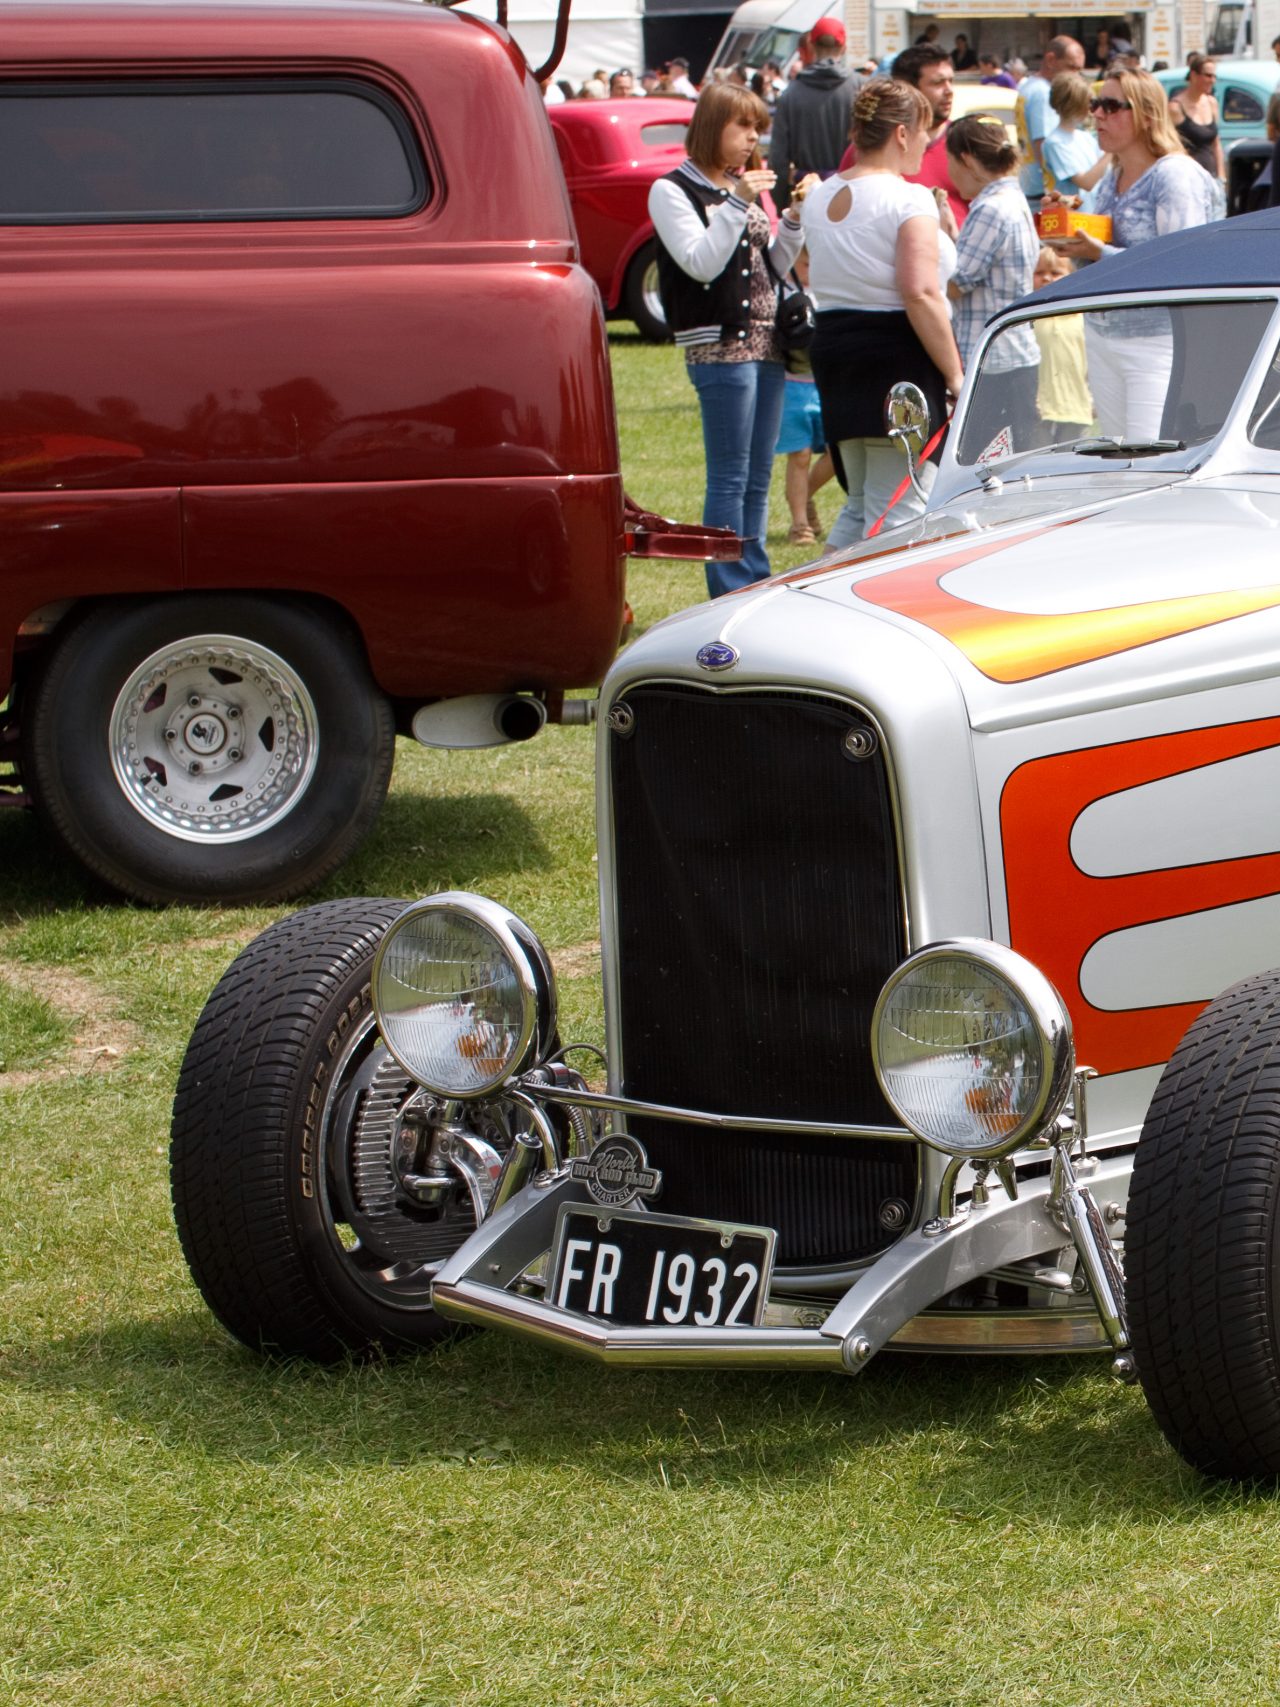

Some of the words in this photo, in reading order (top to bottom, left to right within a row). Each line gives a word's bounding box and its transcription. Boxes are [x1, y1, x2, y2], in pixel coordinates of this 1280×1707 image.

[302, 1061, 329, 1198] COOPER
[327, 982, 372, 1057] COBR
[595, 1151, 639, 1171] World
[573, 1163, 597, 1178] HOT
[600, 1167, 623, 1182] ROD
[624, 1171, 654, 1187] CLUB
[590, 1182, 631, 1203] CHARTER
[557, 1239, 622, 1314] FR
[645, 1250, 759, 1327] 1932
